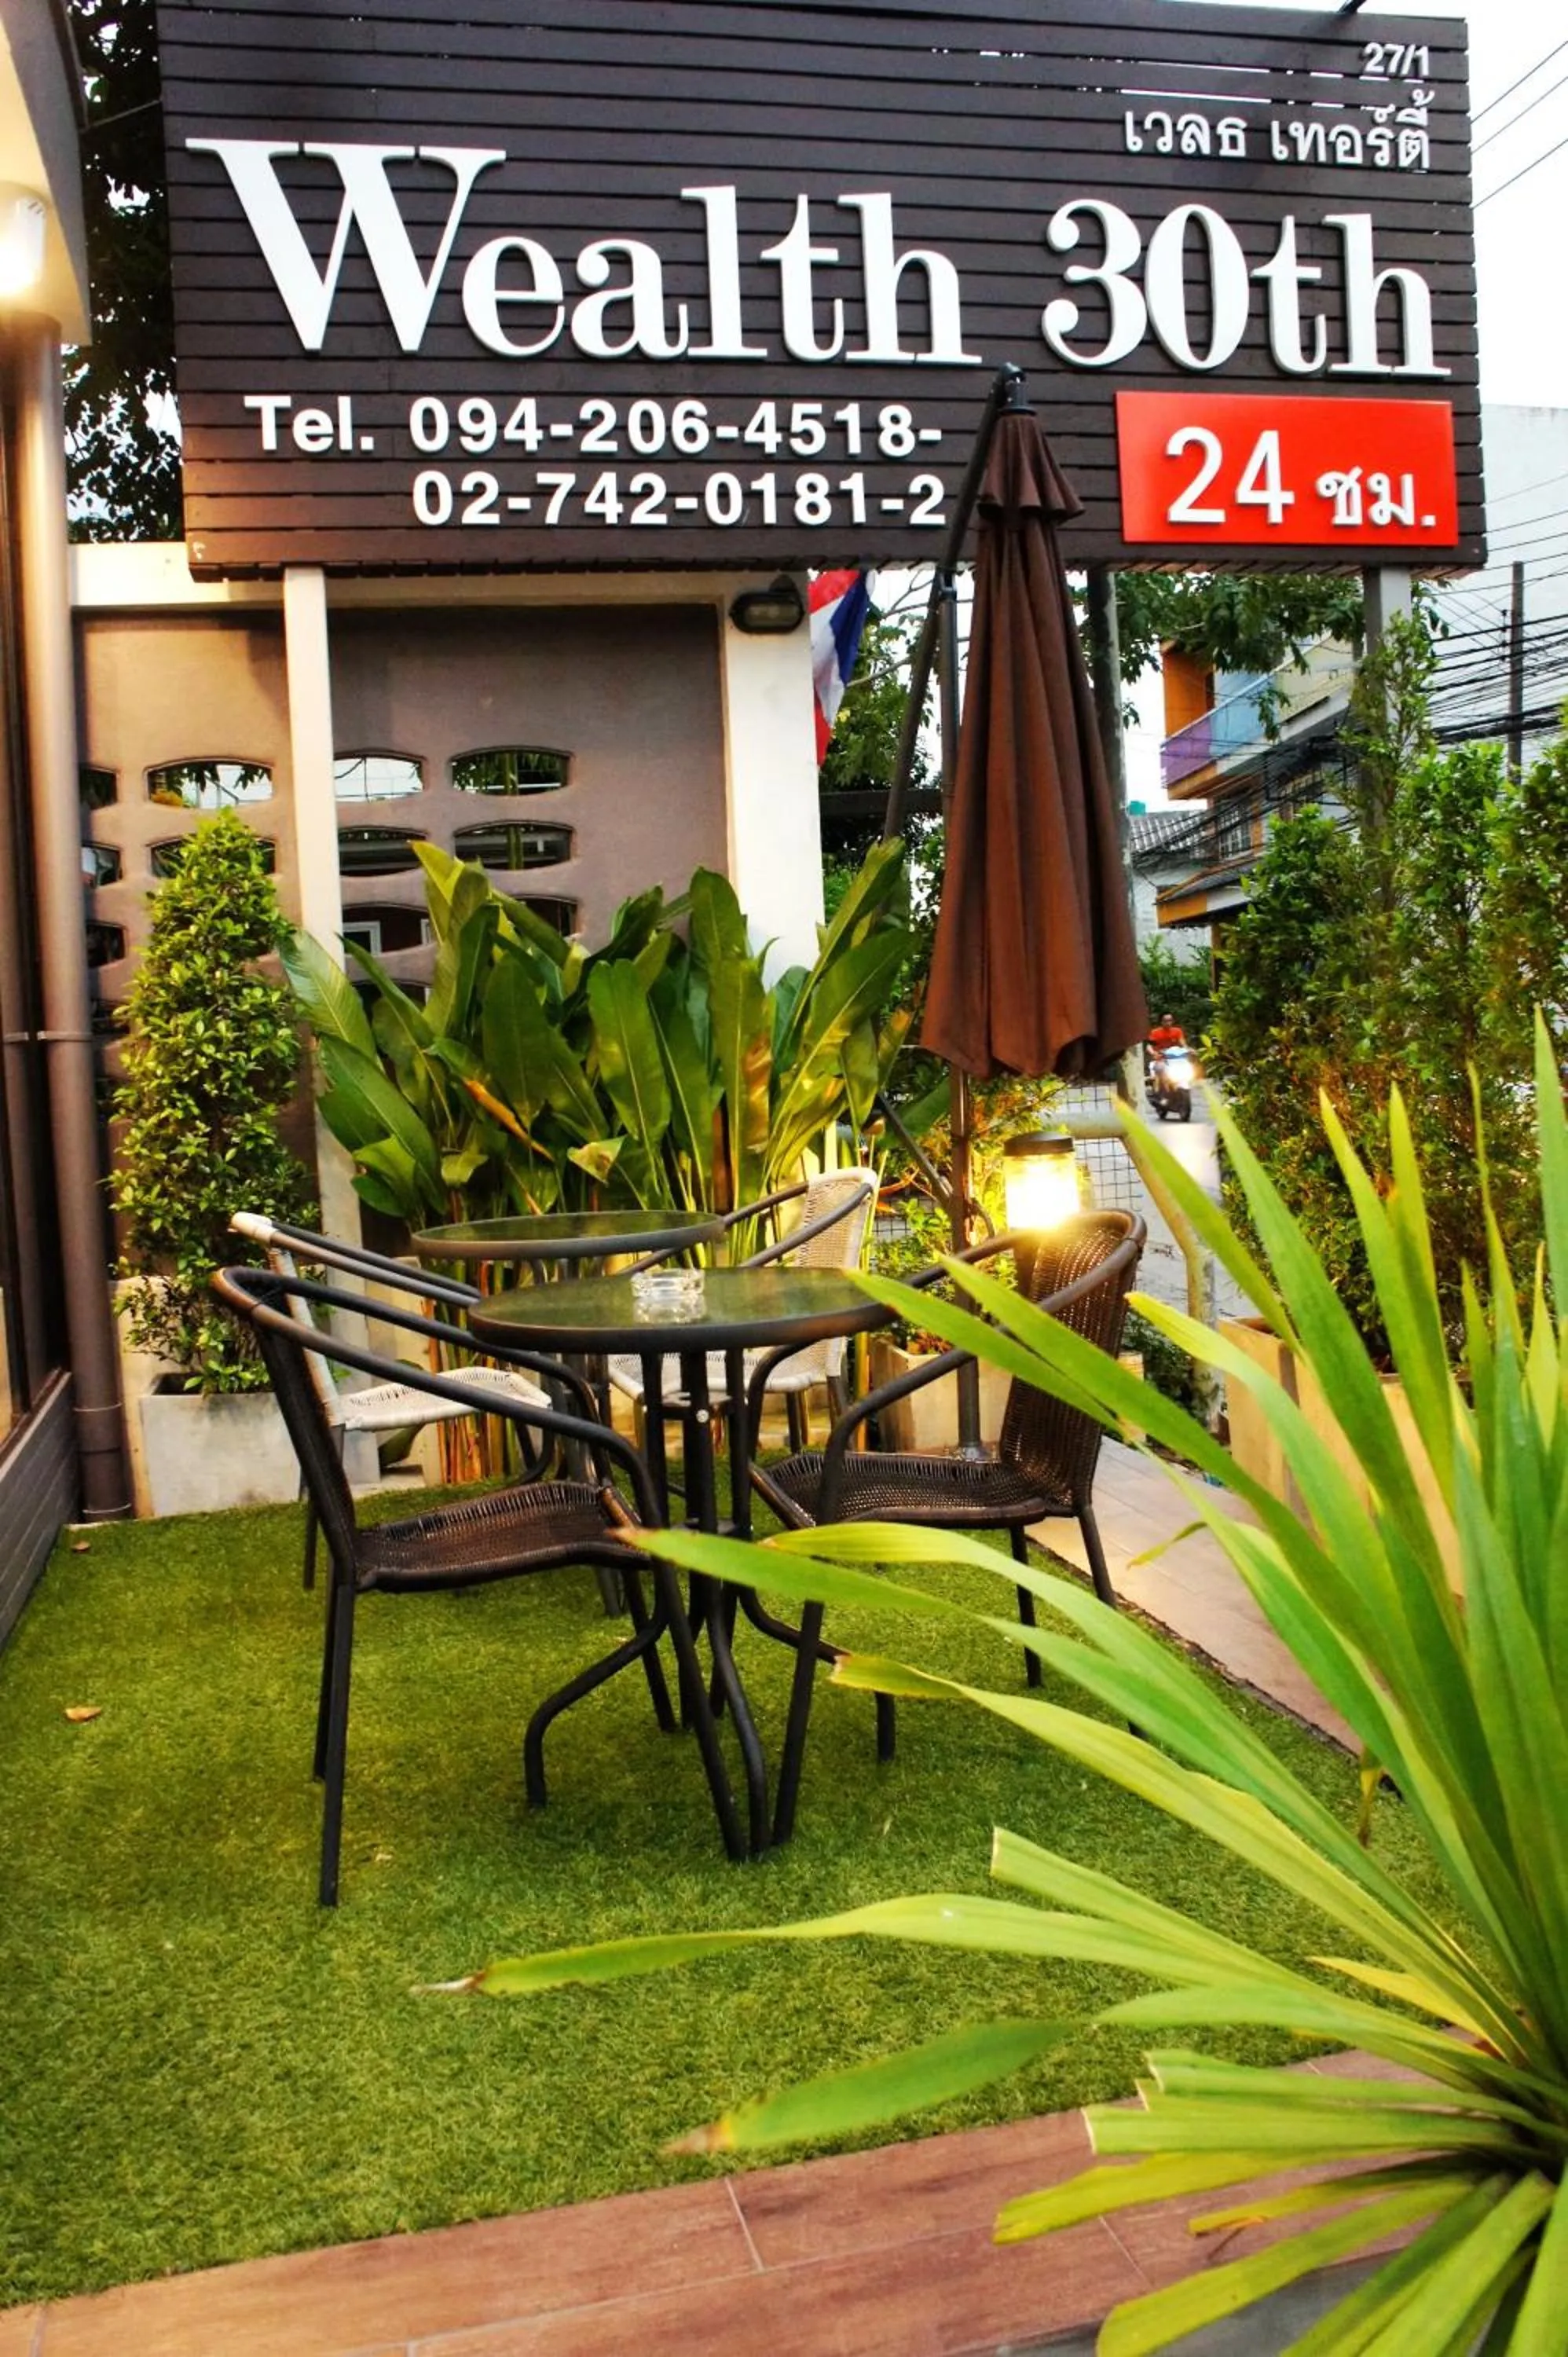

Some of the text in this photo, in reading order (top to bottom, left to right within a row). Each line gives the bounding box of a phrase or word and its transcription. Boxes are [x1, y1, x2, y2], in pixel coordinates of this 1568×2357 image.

[1363, 42, 1431, 76] 27/1
[1123, 109, 1248, 157] เวลธ
[185, 137, 1453, 377] Wealth 30th
[243, 394, 943, 459] Tel. 094-206-4518-
[412, 471, 947, 528] 02-742-0181-2
[1164, 425, 1437, 527] 24 ชม.
